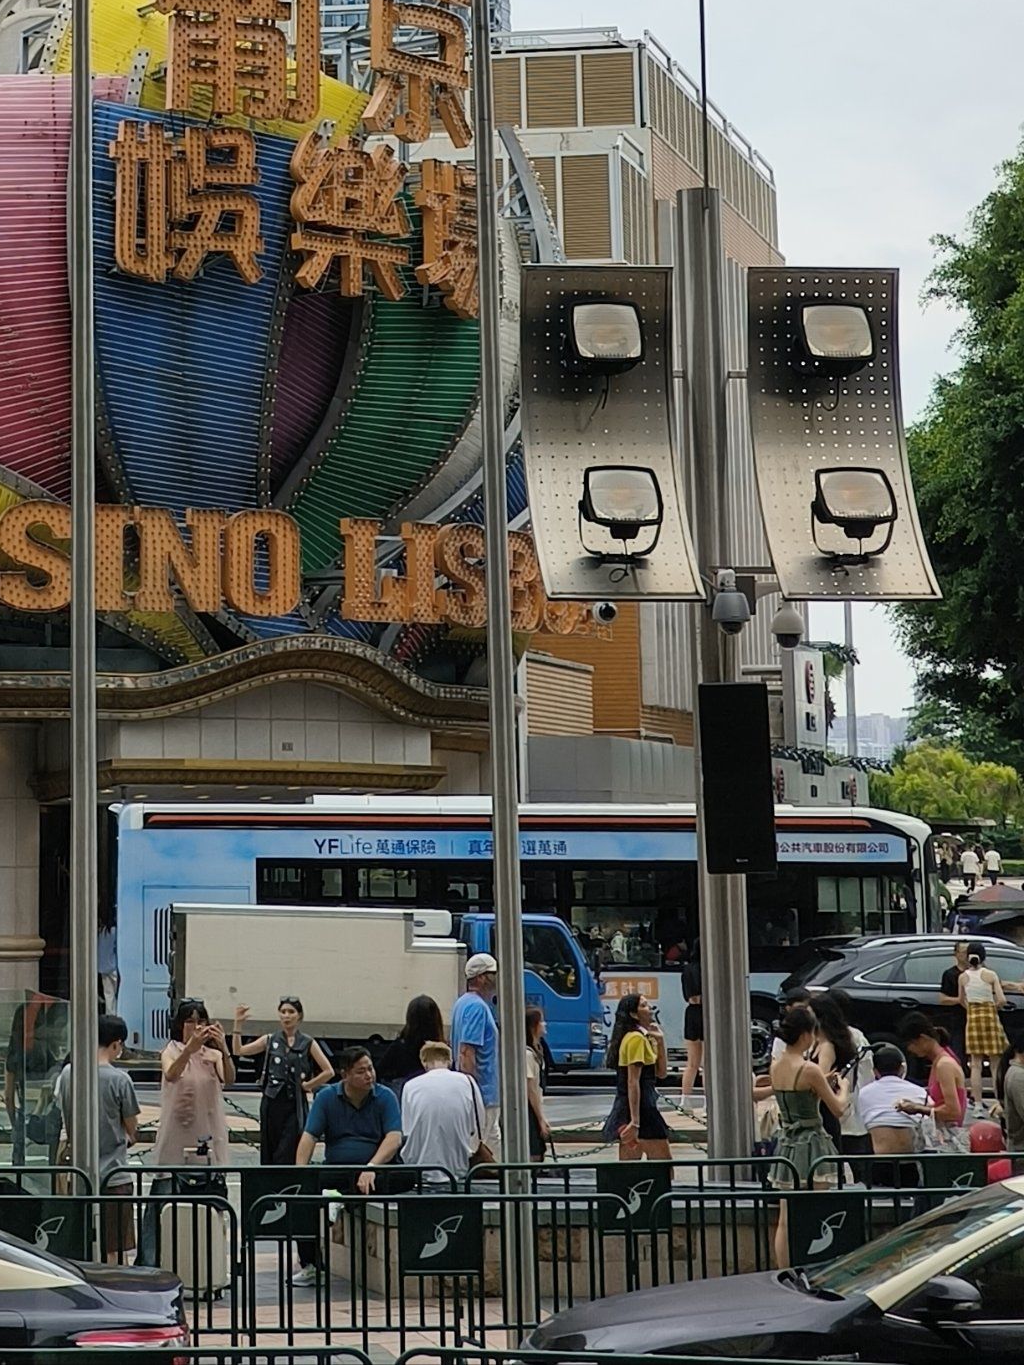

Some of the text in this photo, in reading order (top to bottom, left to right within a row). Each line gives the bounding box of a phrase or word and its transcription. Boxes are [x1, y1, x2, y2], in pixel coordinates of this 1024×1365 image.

[340, 517, 613, 641] LISB
[376, 839, 436, 855] 萬通保險
[776, 842, 889, 854] 公共汽車股份有限公司
